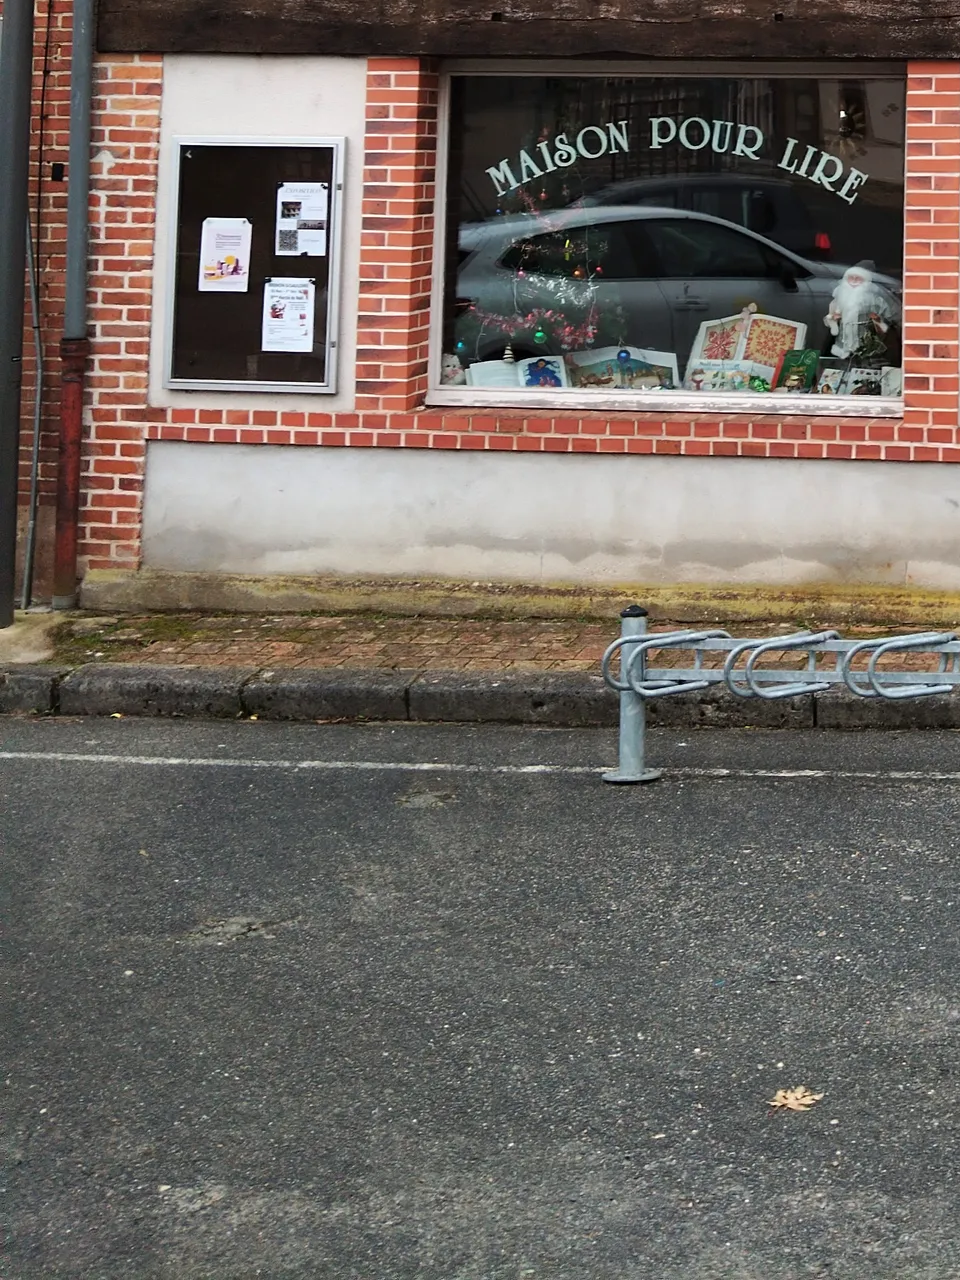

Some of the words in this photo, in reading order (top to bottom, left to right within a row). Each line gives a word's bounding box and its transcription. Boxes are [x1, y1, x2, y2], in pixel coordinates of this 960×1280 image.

[486, 120, 629, 198] MAISON
[649, 116, 765, 162] POUR
[777, 136, 869, 206] LIRE
